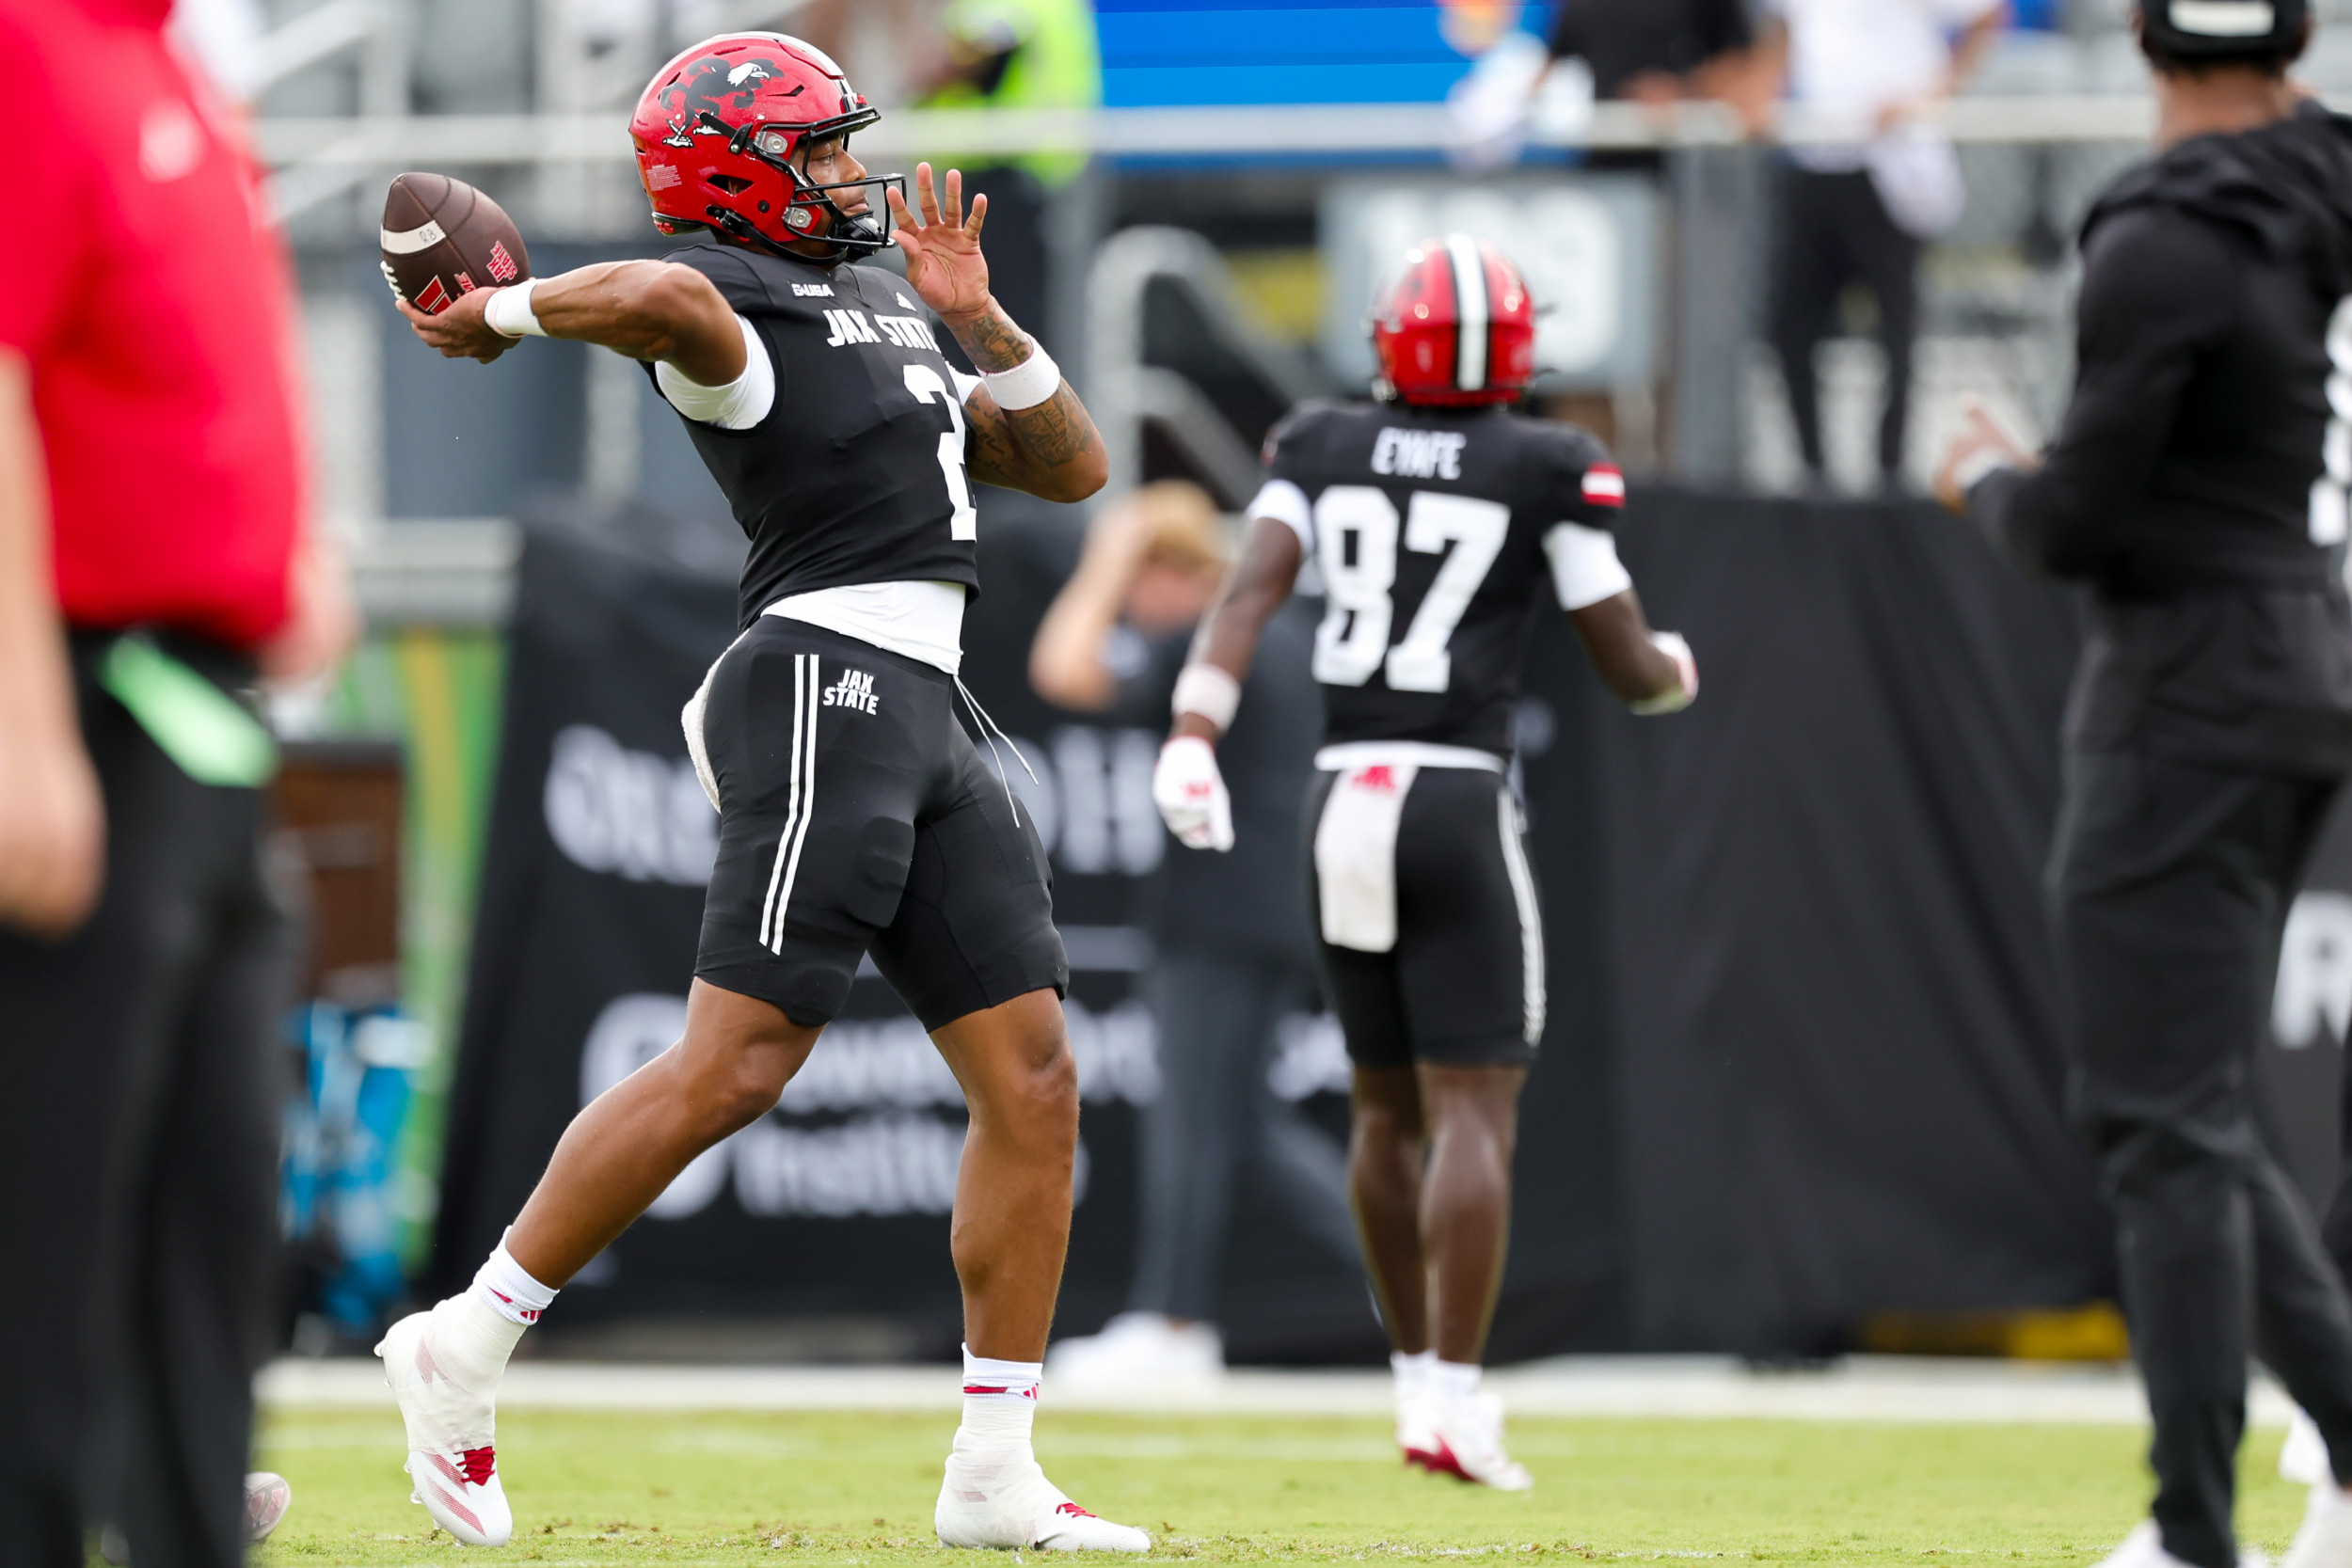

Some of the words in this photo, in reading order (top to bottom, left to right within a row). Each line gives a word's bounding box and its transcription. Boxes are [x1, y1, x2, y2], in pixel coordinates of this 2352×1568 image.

[486, 257, 508, 283] JAX
[490, 240, 518, 280] STATE
[822, 309, 882, 347] JAX
[873, 313, 942, 354] STAT
[903, 364, 977, 543] 2
[1311, 484, 1511, 693] 87
[822, 687, 880, 716] STATE
[836, 669, 875, 694] JAX
